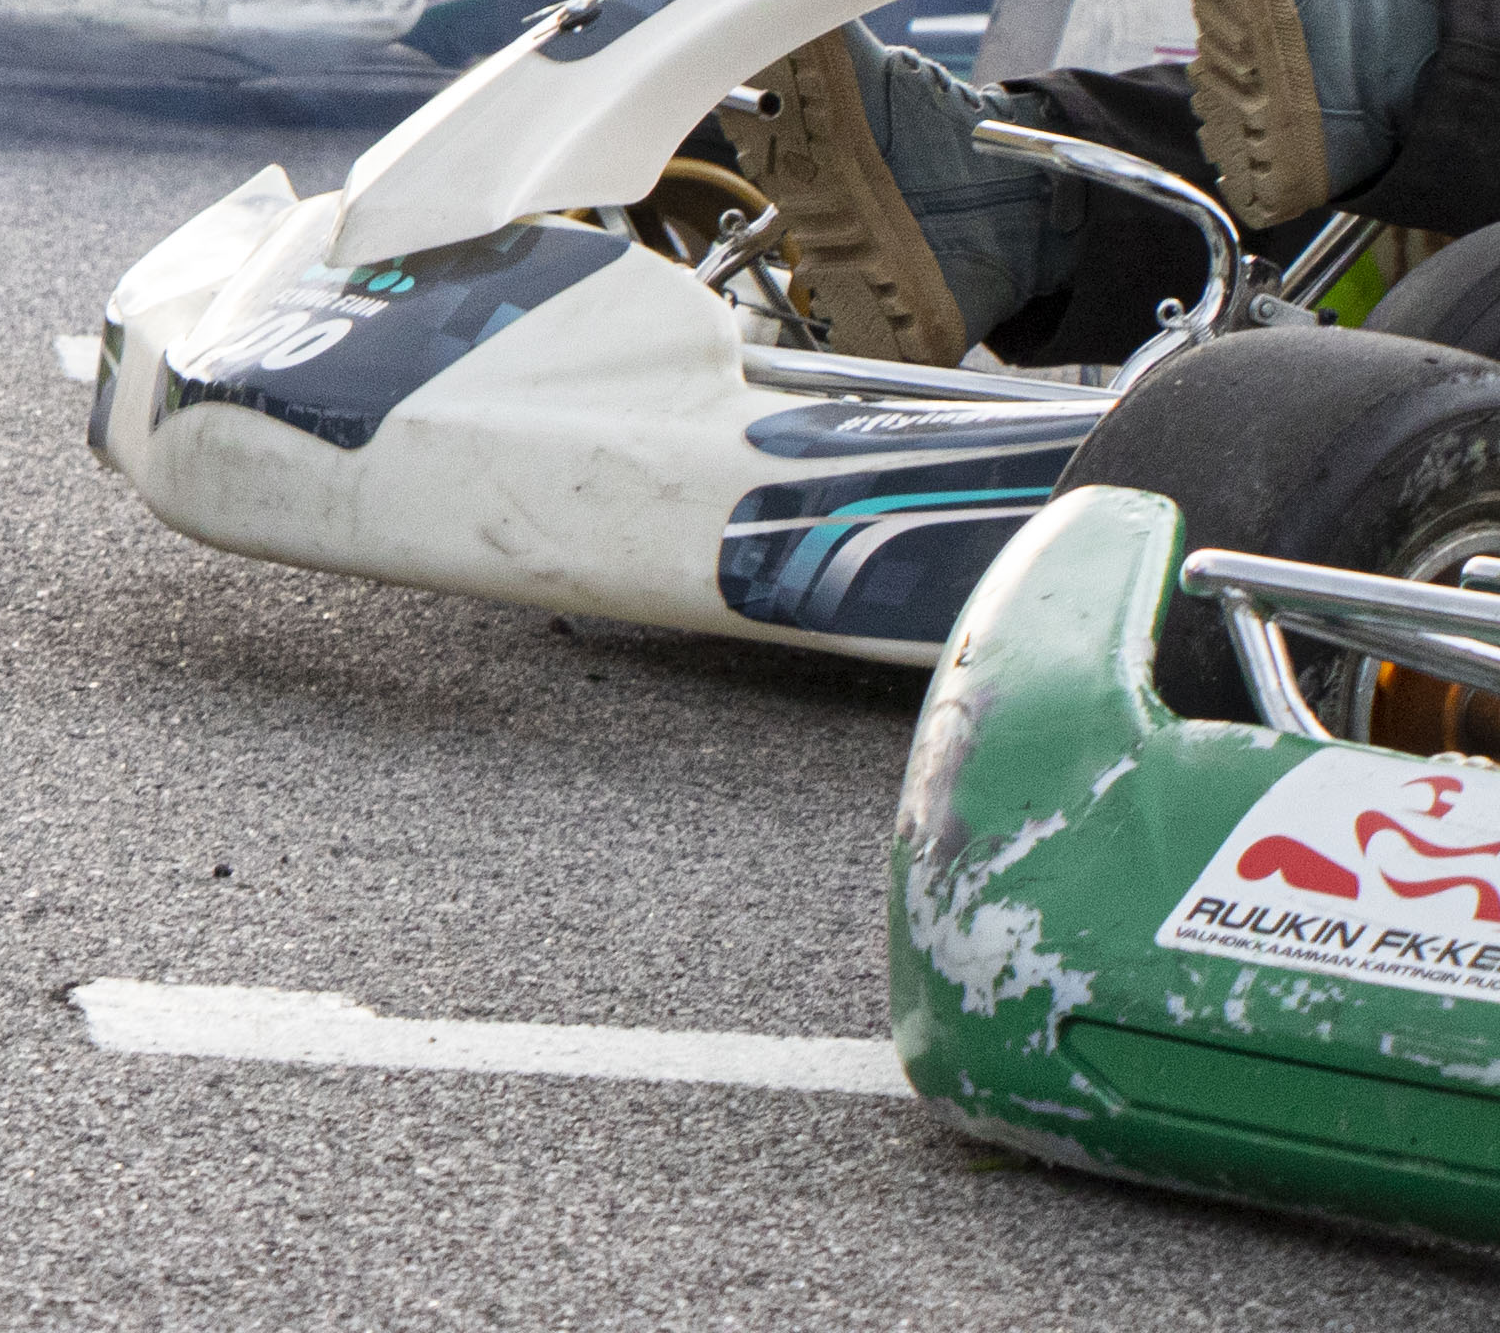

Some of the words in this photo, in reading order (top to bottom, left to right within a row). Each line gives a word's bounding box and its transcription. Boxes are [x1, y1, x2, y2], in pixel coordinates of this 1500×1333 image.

[1175, 926, 1354, 970] VAUHDIKKAAMMAN
[1357, 959, 1462, 985] KARTINGIN
[1186, 896, 1367, 950] RUUKIN
[1367, 928, 1500, 975] FK-KE
